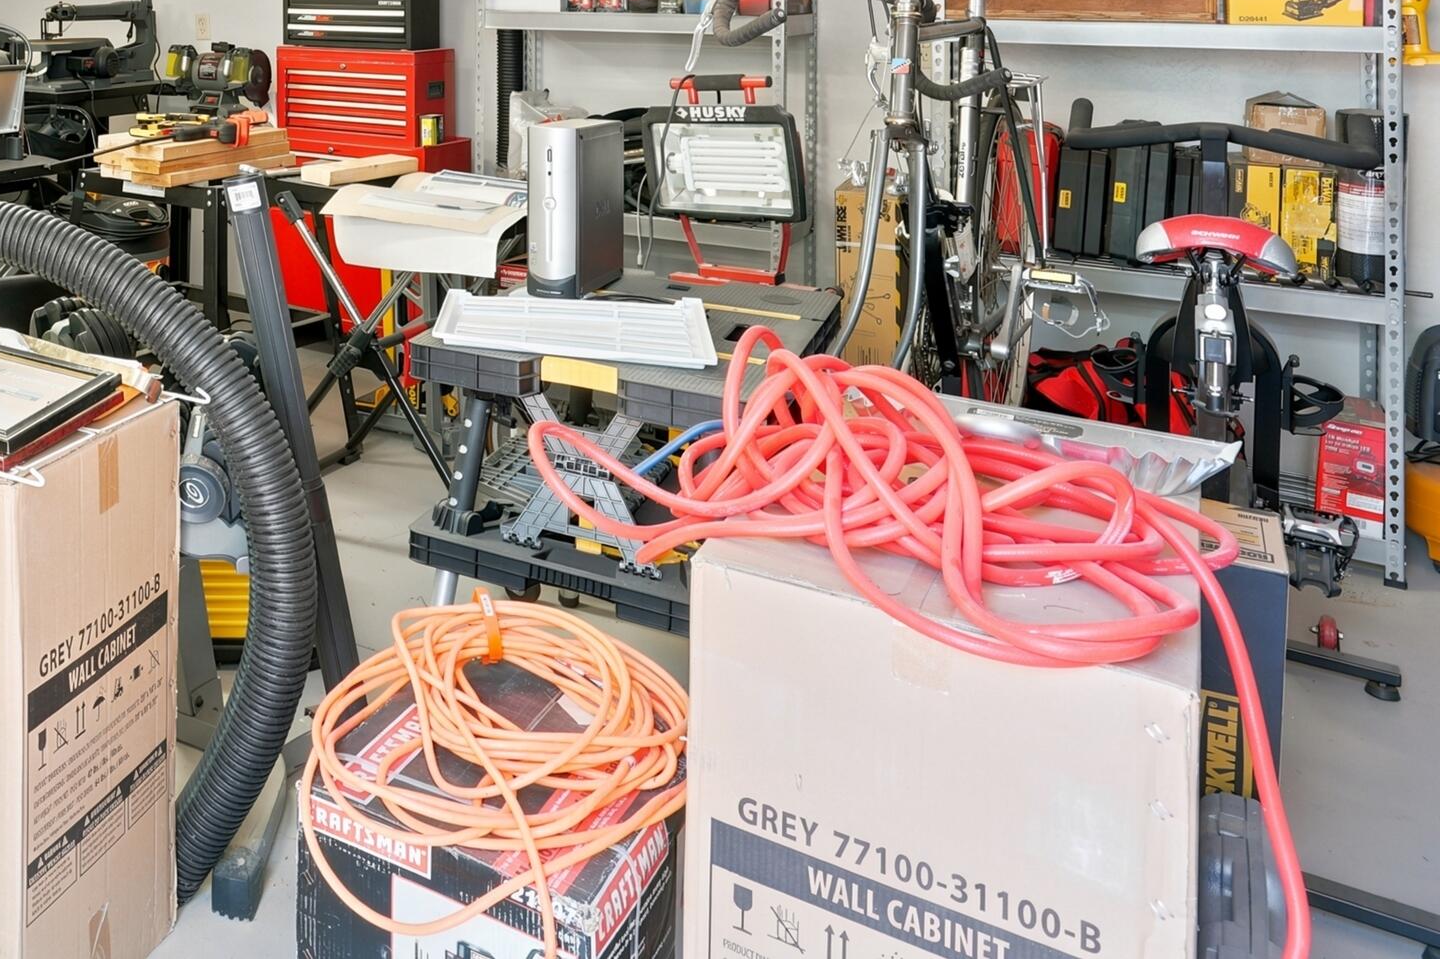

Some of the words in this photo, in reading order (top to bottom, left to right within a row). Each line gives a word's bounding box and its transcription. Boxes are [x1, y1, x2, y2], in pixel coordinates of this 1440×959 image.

[689, 106, 747, 118] HUSKY
[1191, 229, 1240, 239] SCHWINN
[40, 636, 74, 678] GREY
[79, 573, 160, 651] 77100-31100-B
[68, 656, 96, 693] WALL
[98, 623, 137, 670] CABINET
[1205, 701, 1239, 795] KWELL
[312, 806, 422, 866] RAFTSMAN
[737, 796, 819, 846] GREY
[833, 830, 1102, 954] 77100-31100-B
[597, 829, 666, 940] CRAFTMAN
[807, 865, 880, 922] WALL
[886, 900, 1012, 959] CABINET
